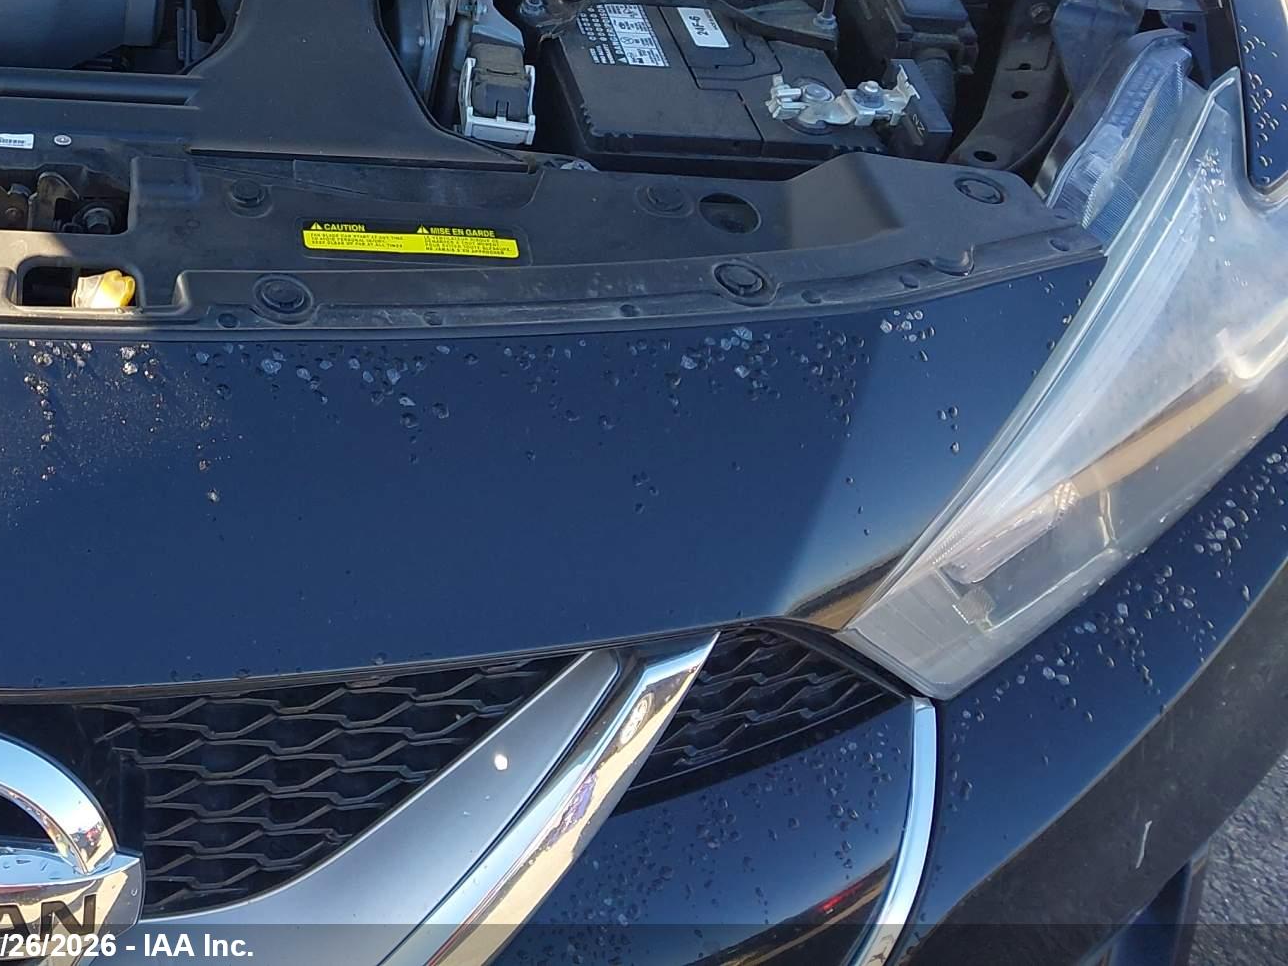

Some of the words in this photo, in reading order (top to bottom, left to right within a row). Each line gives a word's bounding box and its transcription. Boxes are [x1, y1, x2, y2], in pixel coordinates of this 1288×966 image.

[323, 223, 366, 232] CAUTION
[429, 227, 452, 235] MISE
[452, 228, 464, 236] EN
[465, 228, 496, 238] GARDE
